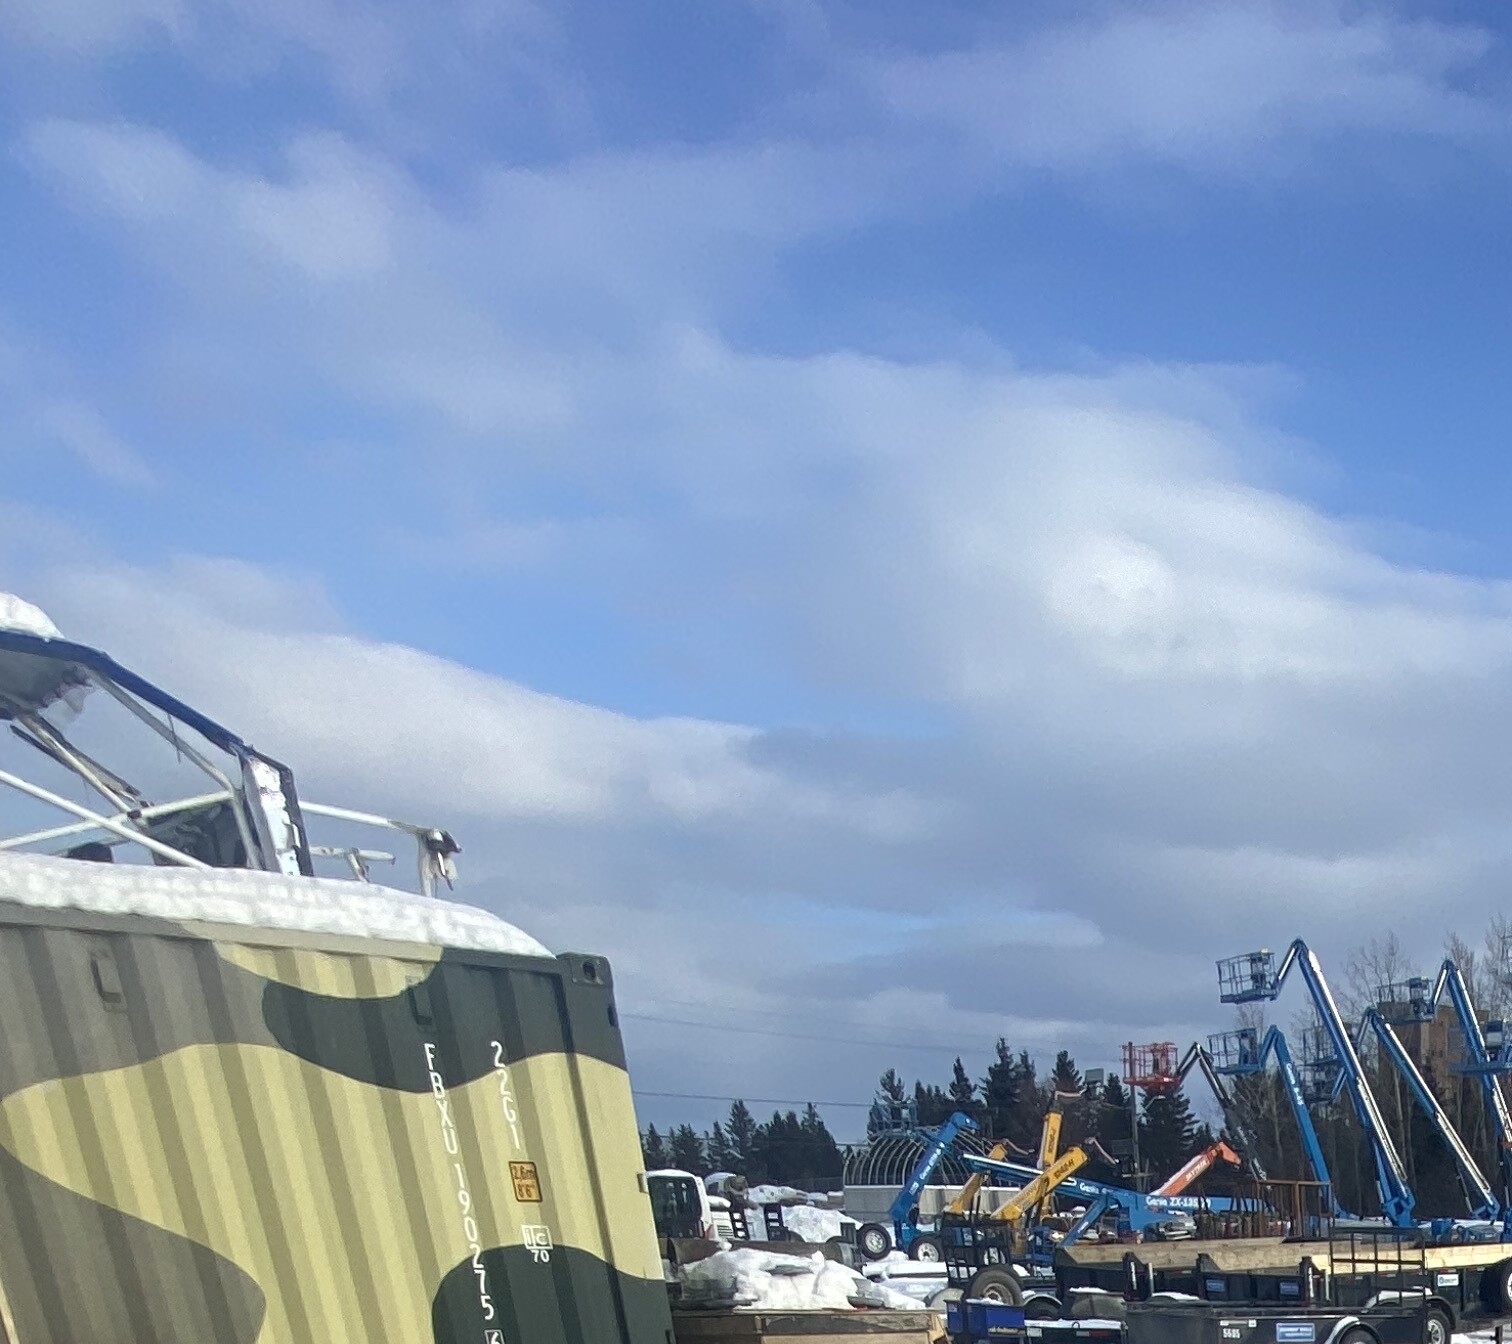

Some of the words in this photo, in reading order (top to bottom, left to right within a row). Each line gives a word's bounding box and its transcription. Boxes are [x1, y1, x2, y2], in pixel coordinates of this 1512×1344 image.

[491, 1041, 521, 1150] 22G1
[424, 1042, 458, 1155] FBXU
[454, 1163, 495, 1321] 190275
[531, 1249, 549, 1262] 70
